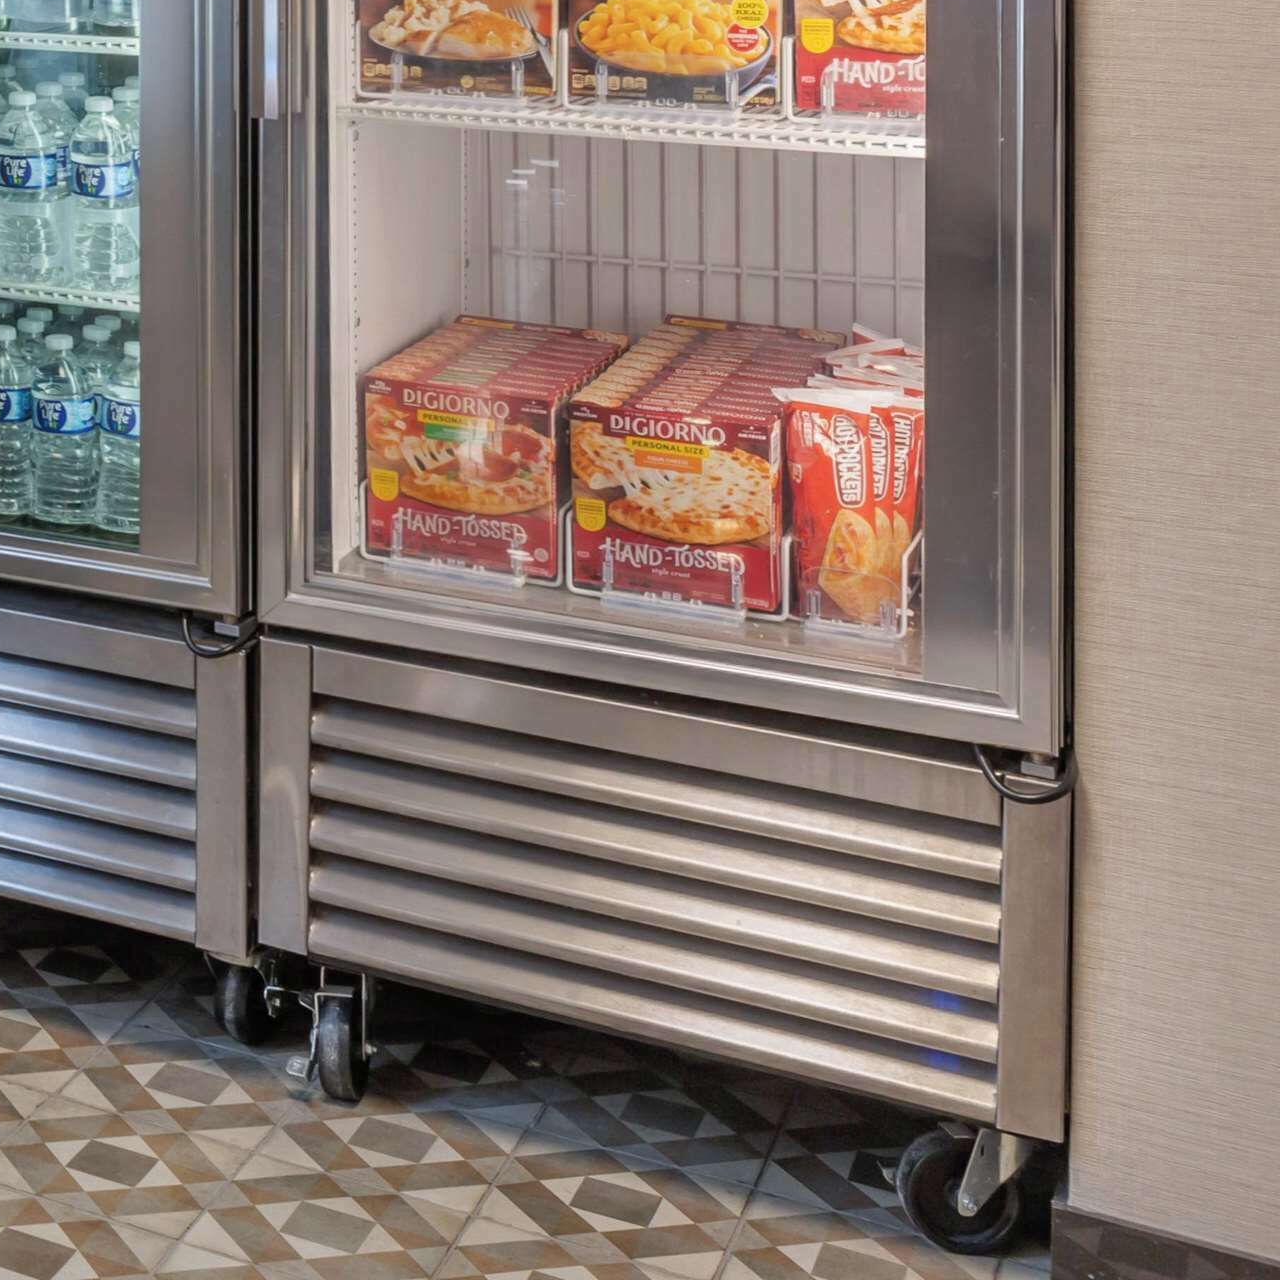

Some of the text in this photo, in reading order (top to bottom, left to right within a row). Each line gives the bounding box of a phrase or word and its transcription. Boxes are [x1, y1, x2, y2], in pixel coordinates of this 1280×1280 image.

[631, 439, 705, 456] PERSONAL SIZE
[834, 417, 862, 502] HOT POCKETS
[392, 507, 528, 544] HAND-TOSSED
[599, 537, 746, 575] HAND-TOSSED
